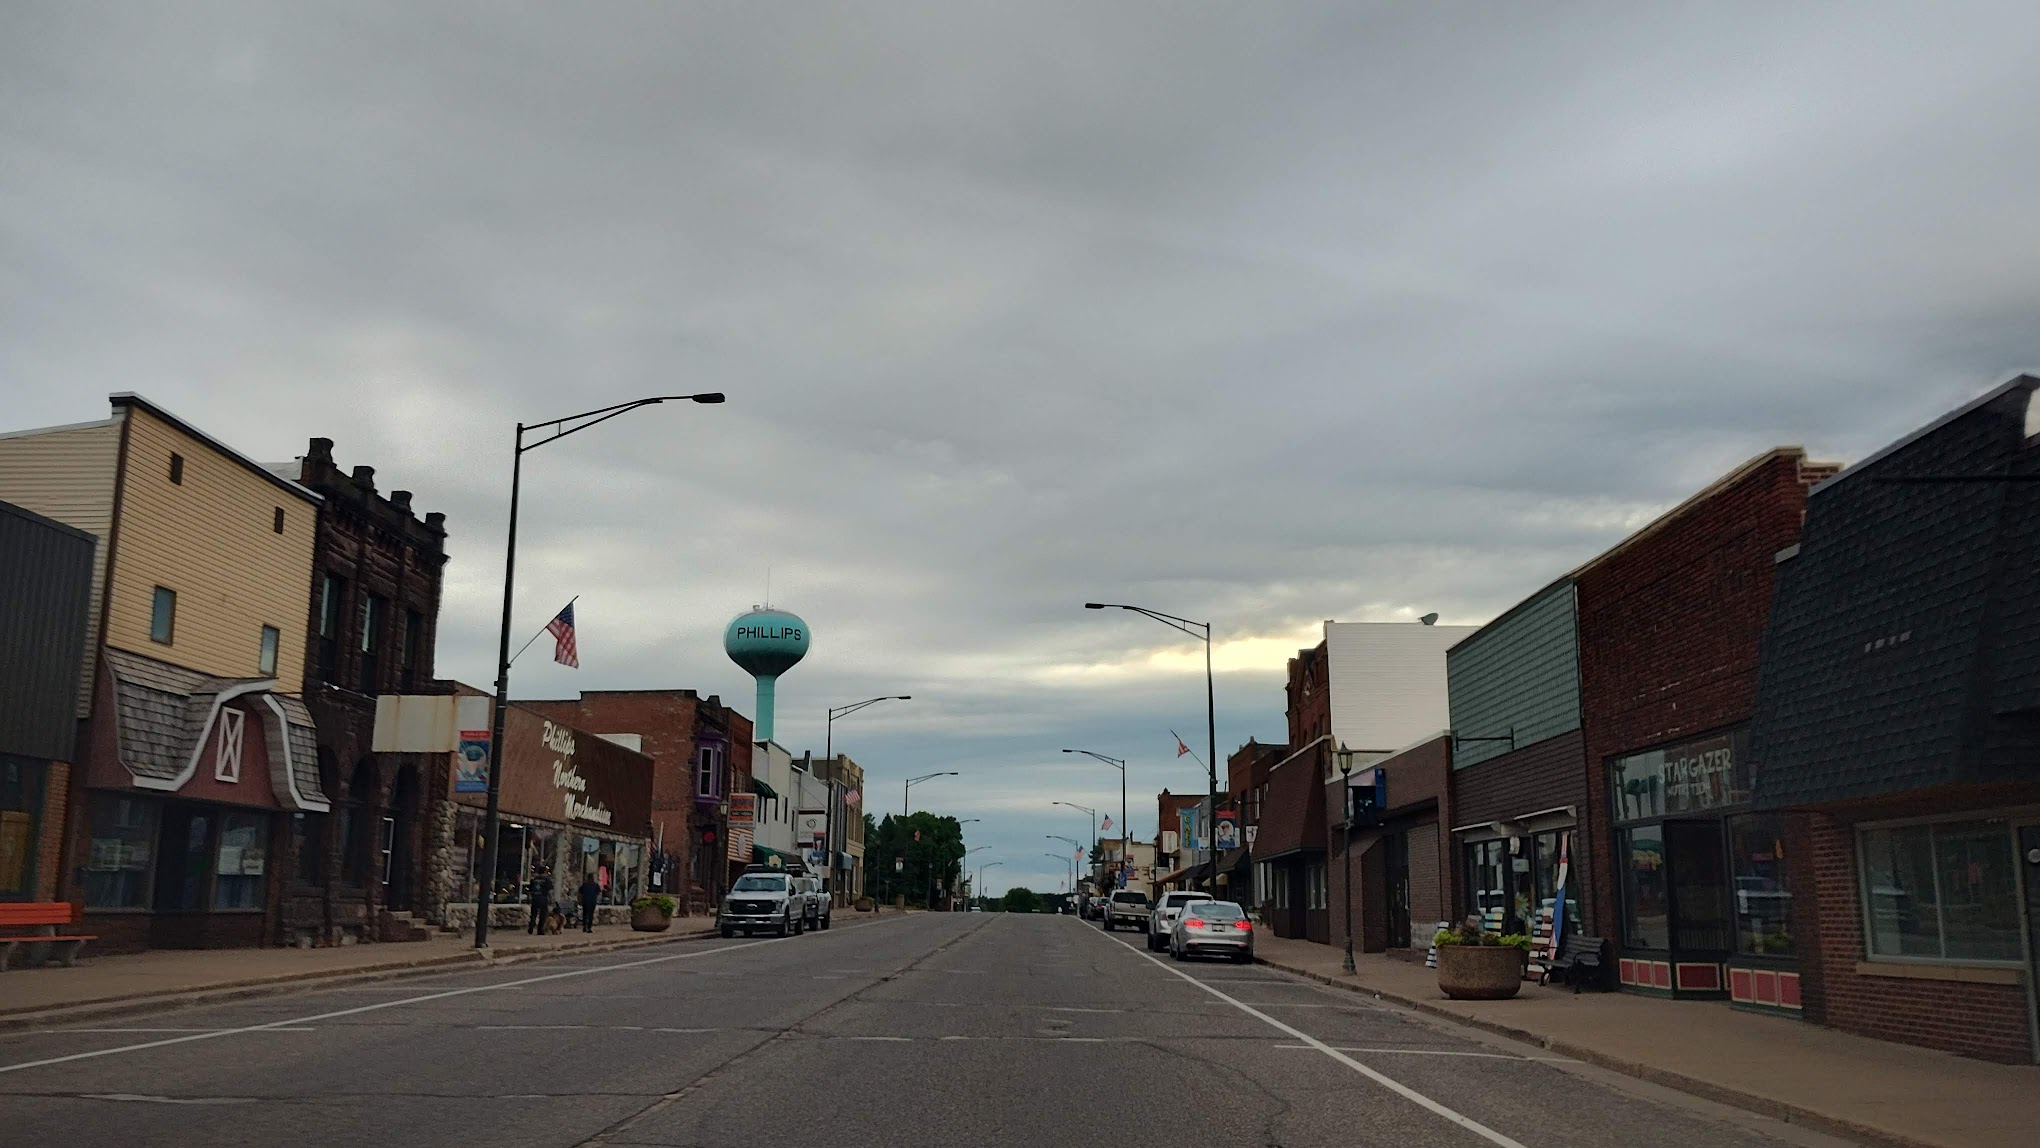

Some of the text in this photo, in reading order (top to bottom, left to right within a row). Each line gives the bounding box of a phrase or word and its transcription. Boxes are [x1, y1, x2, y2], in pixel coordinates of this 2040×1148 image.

[737, 626, 802, 641] PHILLIPS
[542, 720, 576, 761] Phillips
[553, 759, 587, 792] Northern
[1657, 748, 1732, 784] STARGAZER
